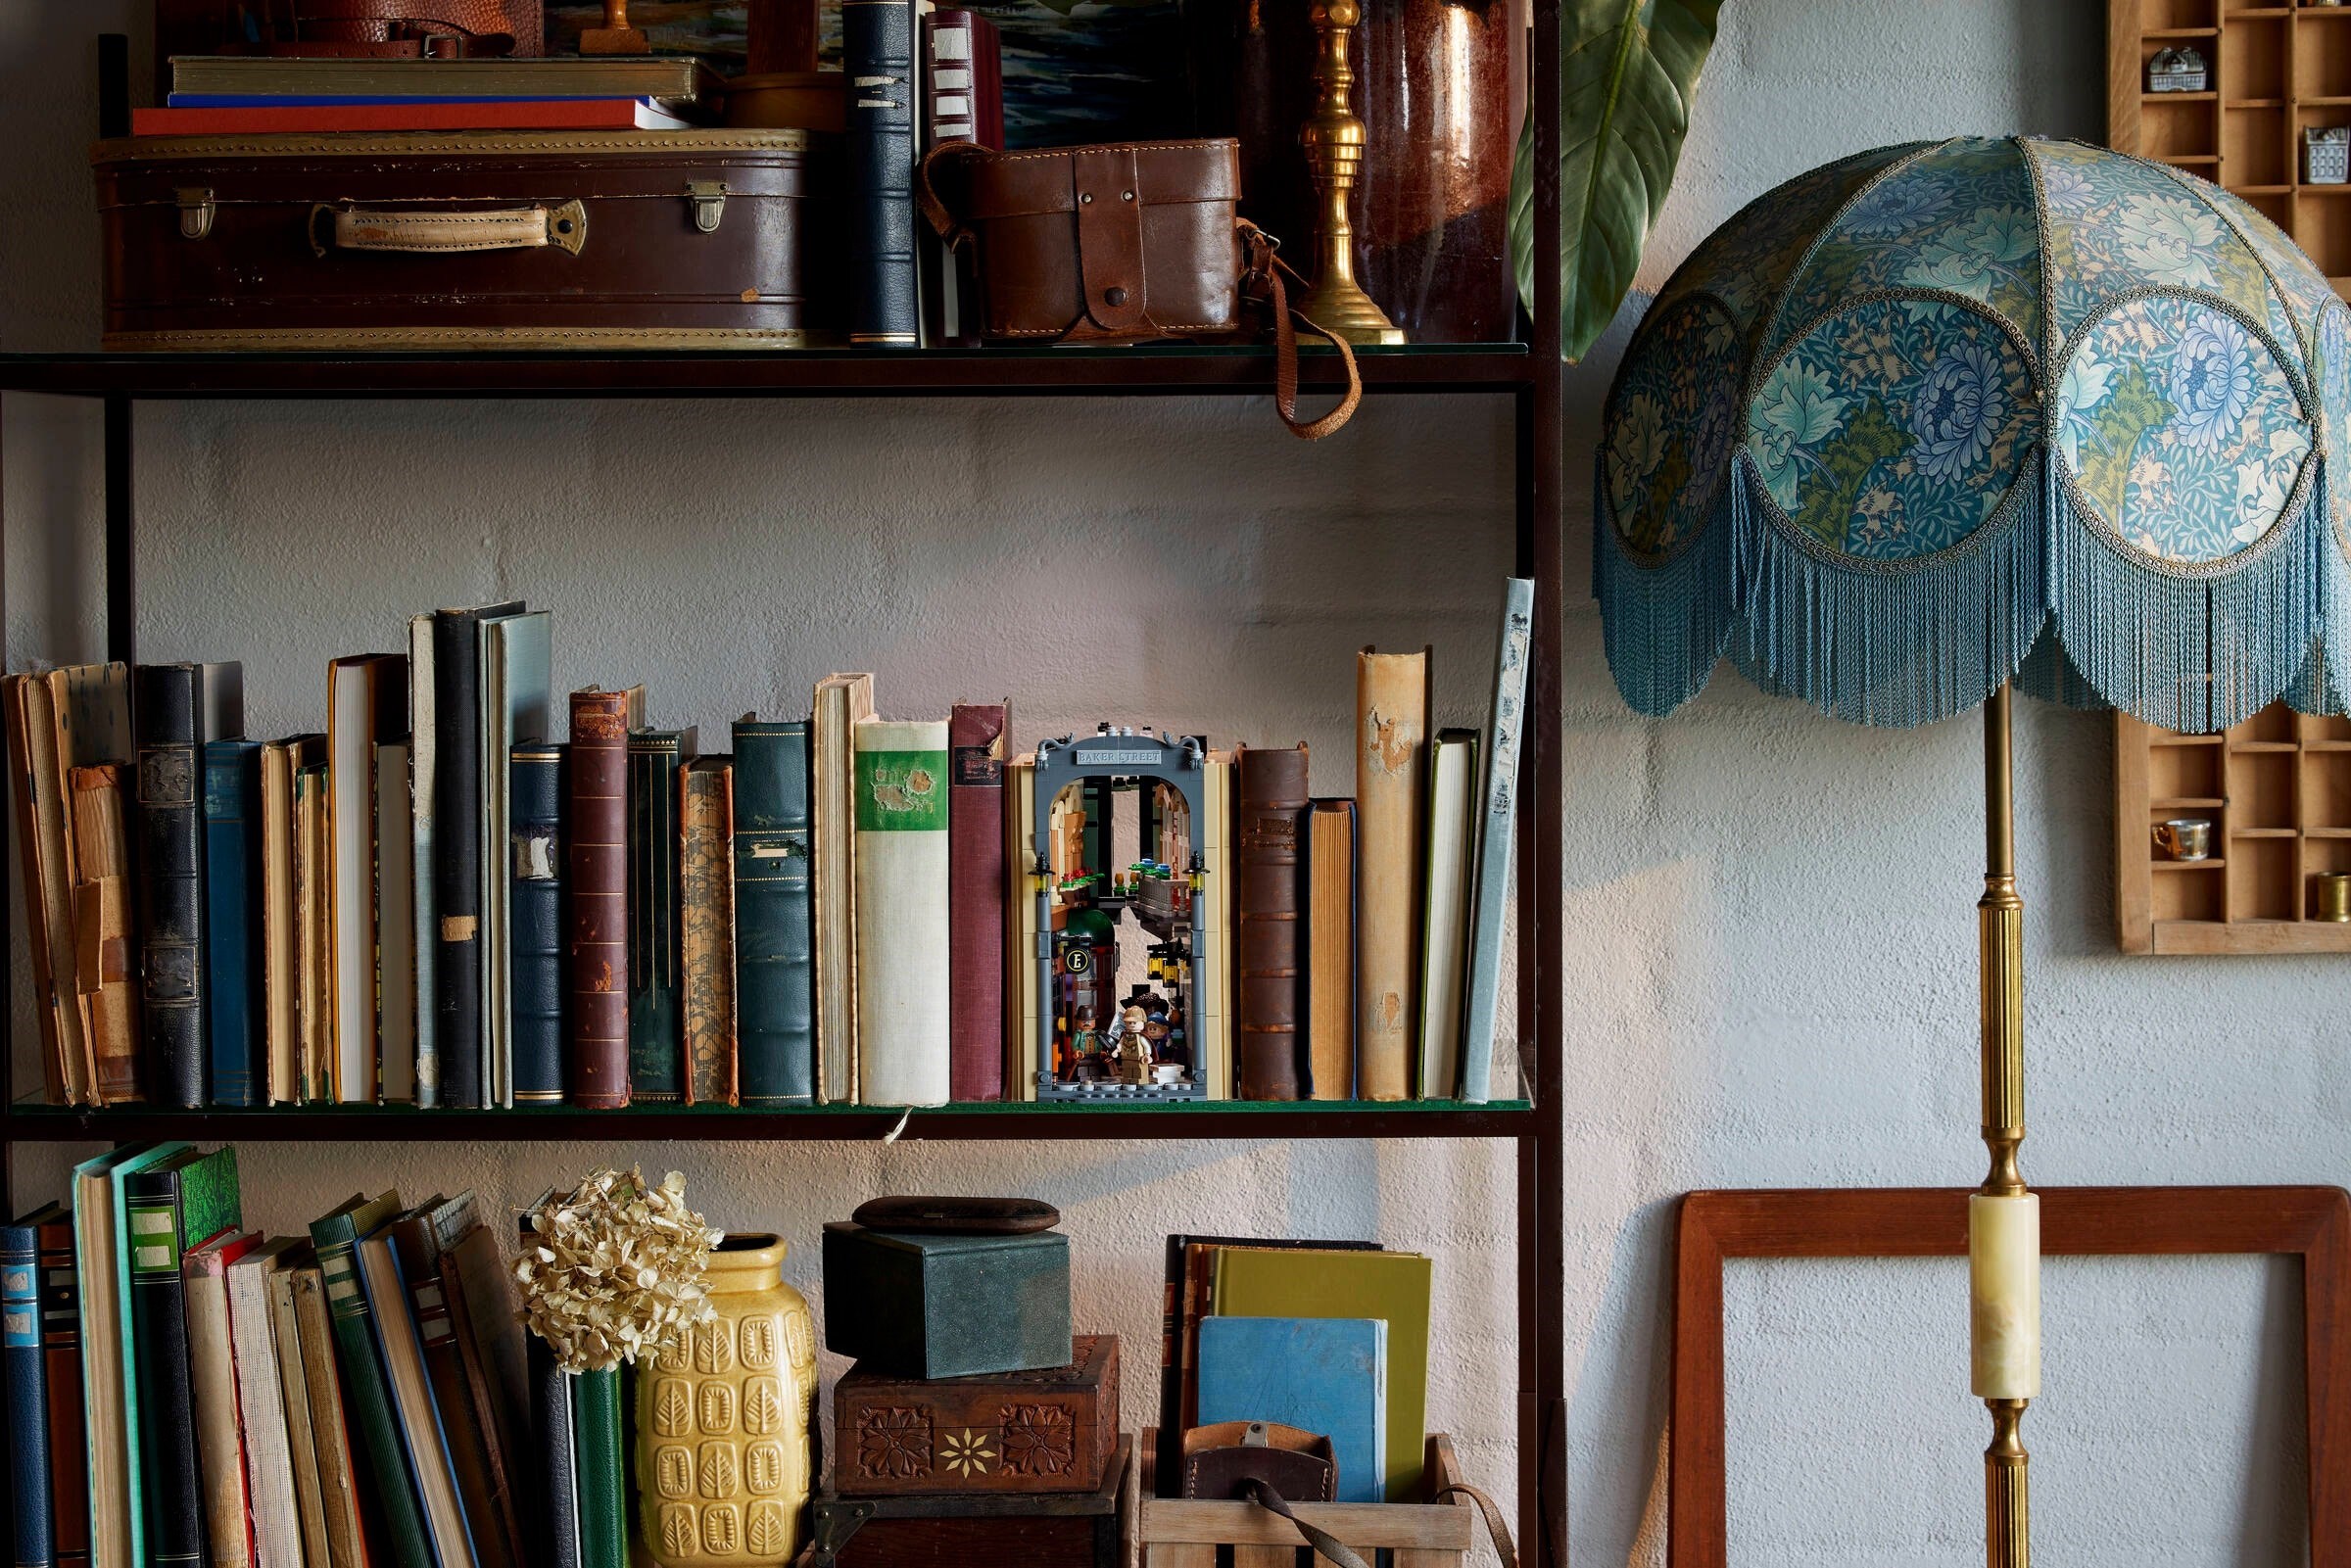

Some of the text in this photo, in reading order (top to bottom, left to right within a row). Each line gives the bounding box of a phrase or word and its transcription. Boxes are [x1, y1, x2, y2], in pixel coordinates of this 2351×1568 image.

[1079, 751, 1161, 763] BAKER STREET
[1074, 953, 1081, 968] E
